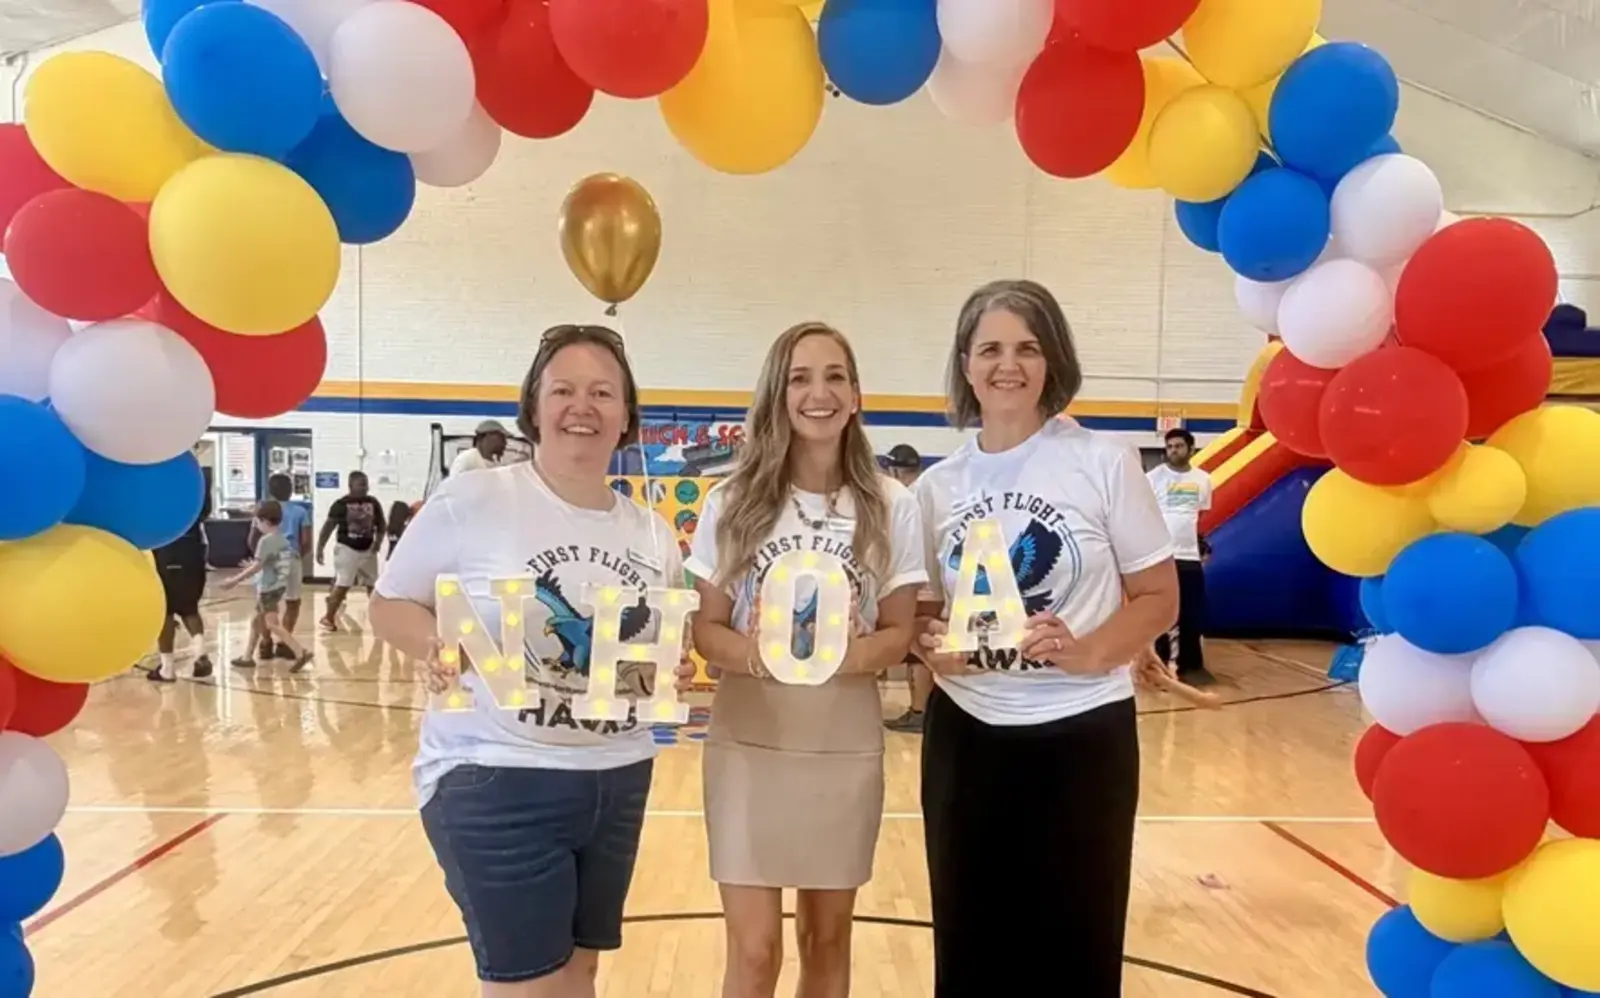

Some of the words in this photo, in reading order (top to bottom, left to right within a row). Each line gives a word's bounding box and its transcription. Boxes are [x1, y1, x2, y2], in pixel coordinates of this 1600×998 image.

[1003, 492, 1065, 526] FLIGHT
[527, 545, 579, 574] FIRST
[811, 536, 861, 577] FLIGH
